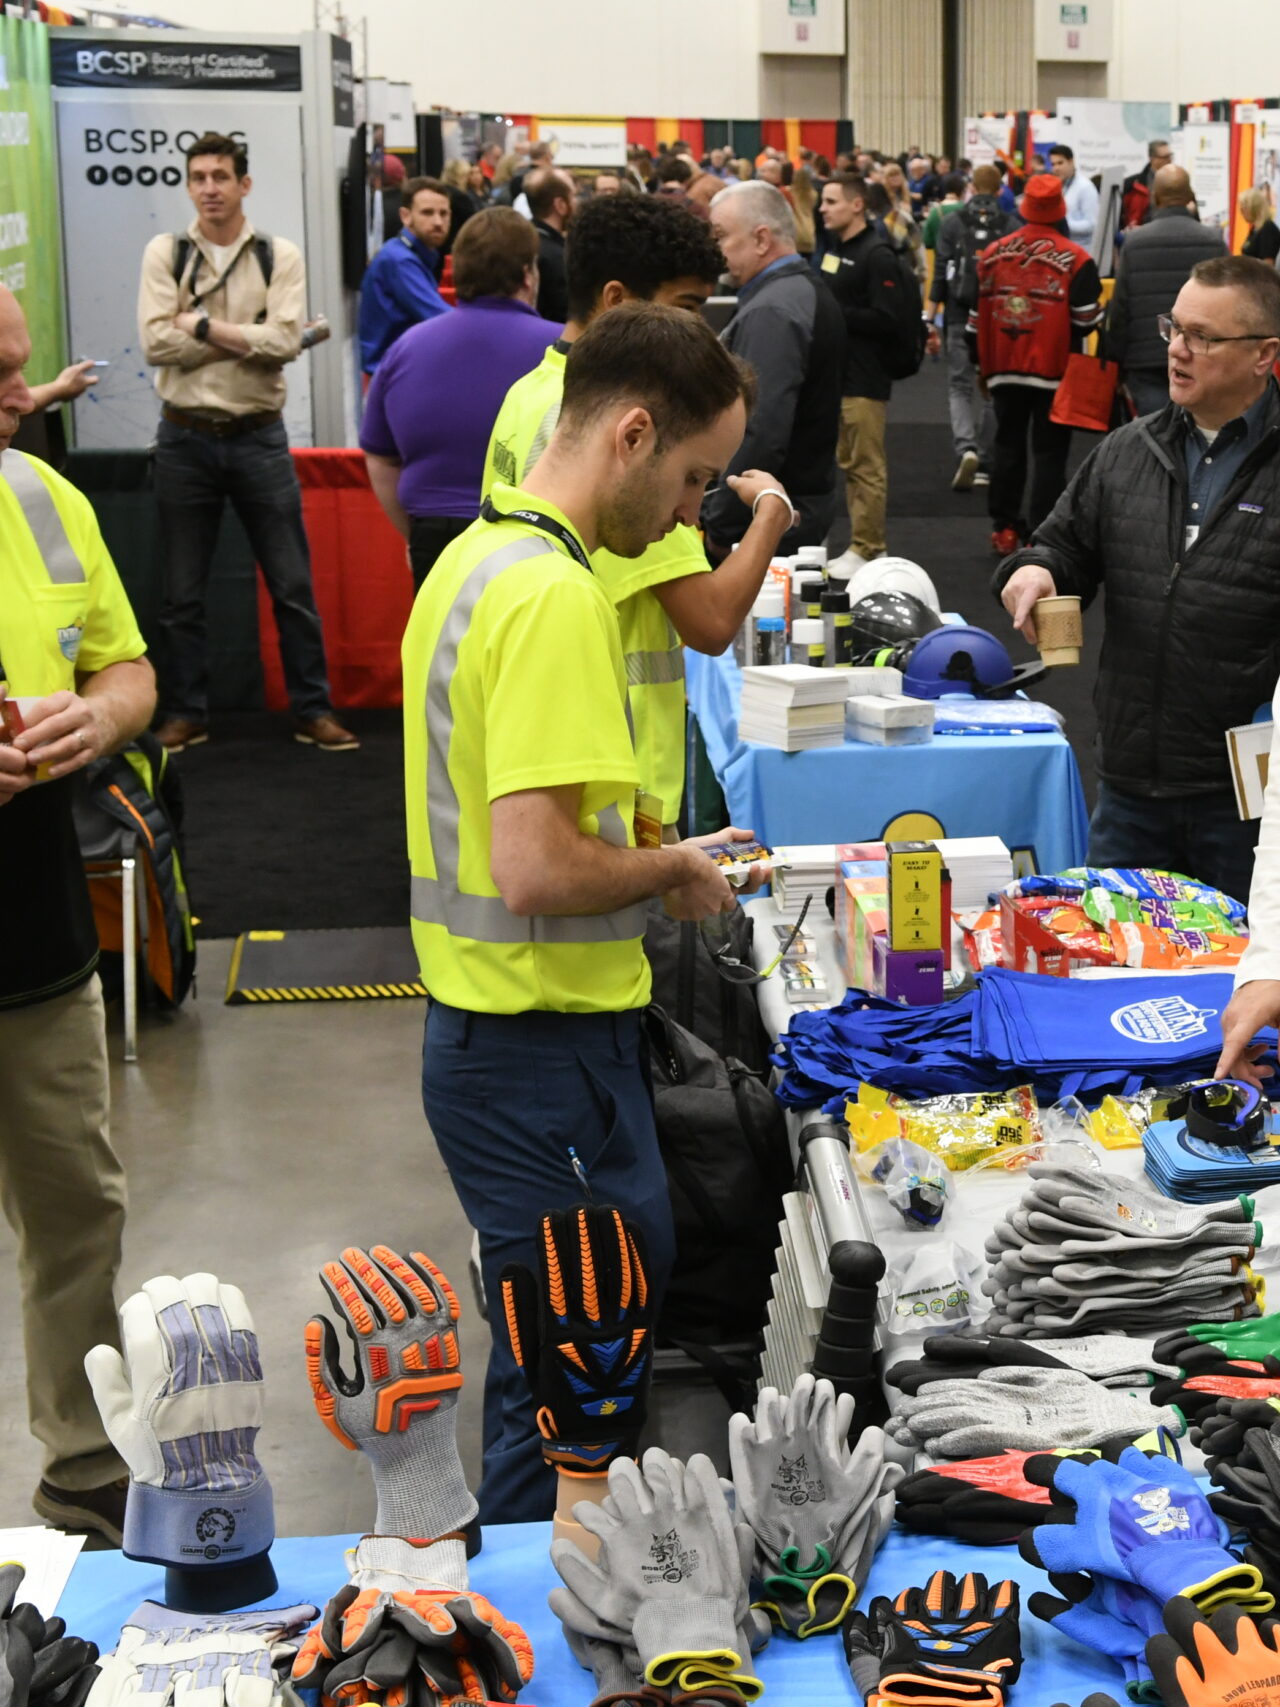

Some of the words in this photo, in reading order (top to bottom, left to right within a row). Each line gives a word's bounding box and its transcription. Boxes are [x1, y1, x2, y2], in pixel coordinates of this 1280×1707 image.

[76, 51, 147, 75] BCSP
[151, 52, 189, 66] Board
[191, 54, 206, 65] of
[208, 53, 264, 68] Certified
[194, 66, 276, 79] Professionals
[84, 128, 248, 154] BCSP.OG
[1149, 995, 1208, 1042] INDIANA
[770, 1483, 801, 1491] BOBCAT
[641, 1561, 675, 1571] BOBCAT
[1221, 1684, 1247, 1702] SNOW
